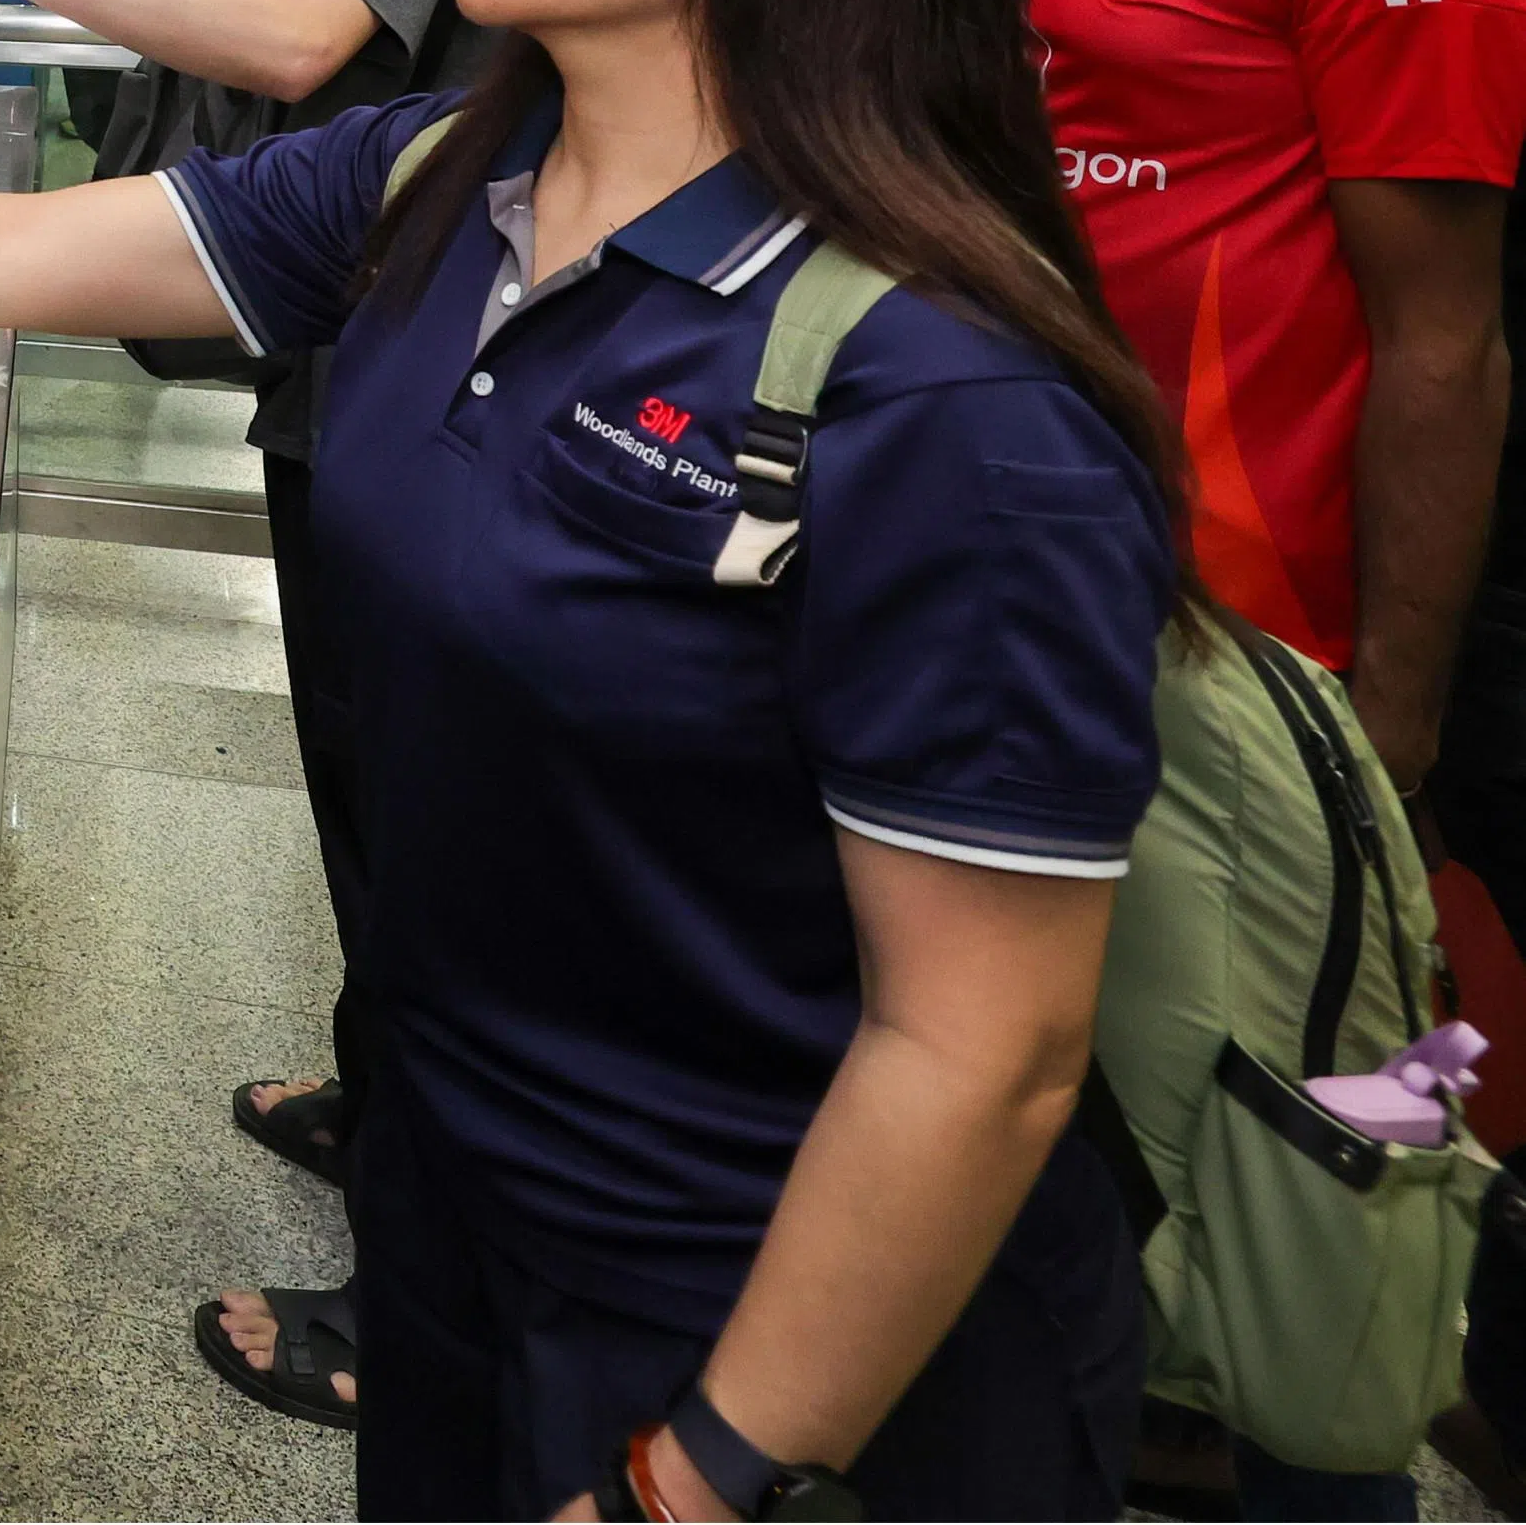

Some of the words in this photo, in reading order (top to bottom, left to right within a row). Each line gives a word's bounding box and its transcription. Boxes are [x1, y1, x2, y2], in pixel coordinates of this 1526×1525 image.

[1055, 147, 1167, 191] gon
[636, 396, 691, 444] 3M
[575, 401, 667, 471] Woodlands
[672, 457, 738, 499] Plant
